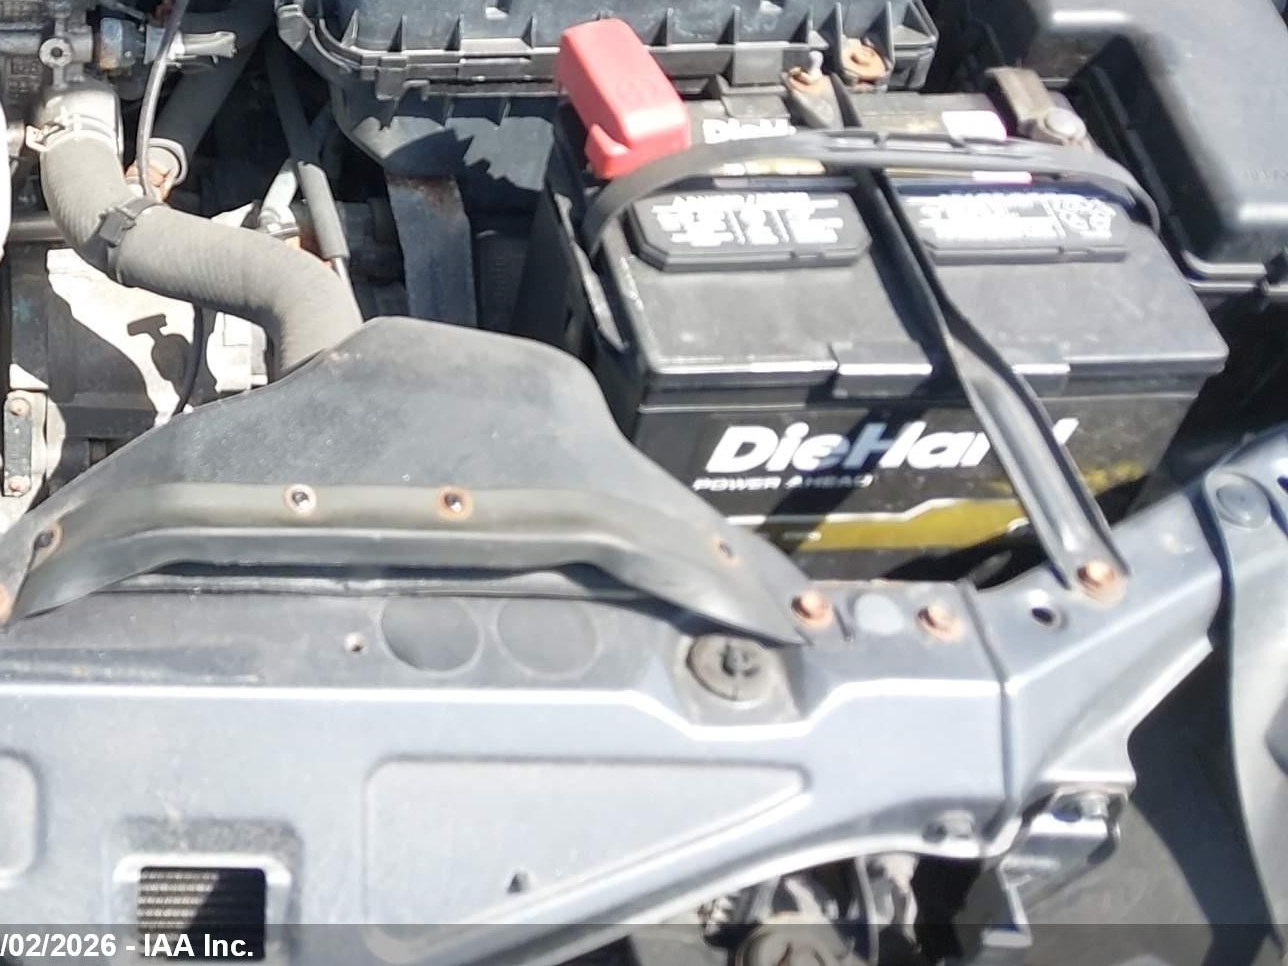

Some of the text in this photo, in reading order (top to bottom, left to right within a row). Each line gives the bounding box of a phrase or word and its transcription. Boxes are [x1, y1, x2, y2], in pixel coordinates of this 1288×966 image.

[704, 417, 1080, 474] DieHar
[692, 474, 874, 492] POWER AHEAD
